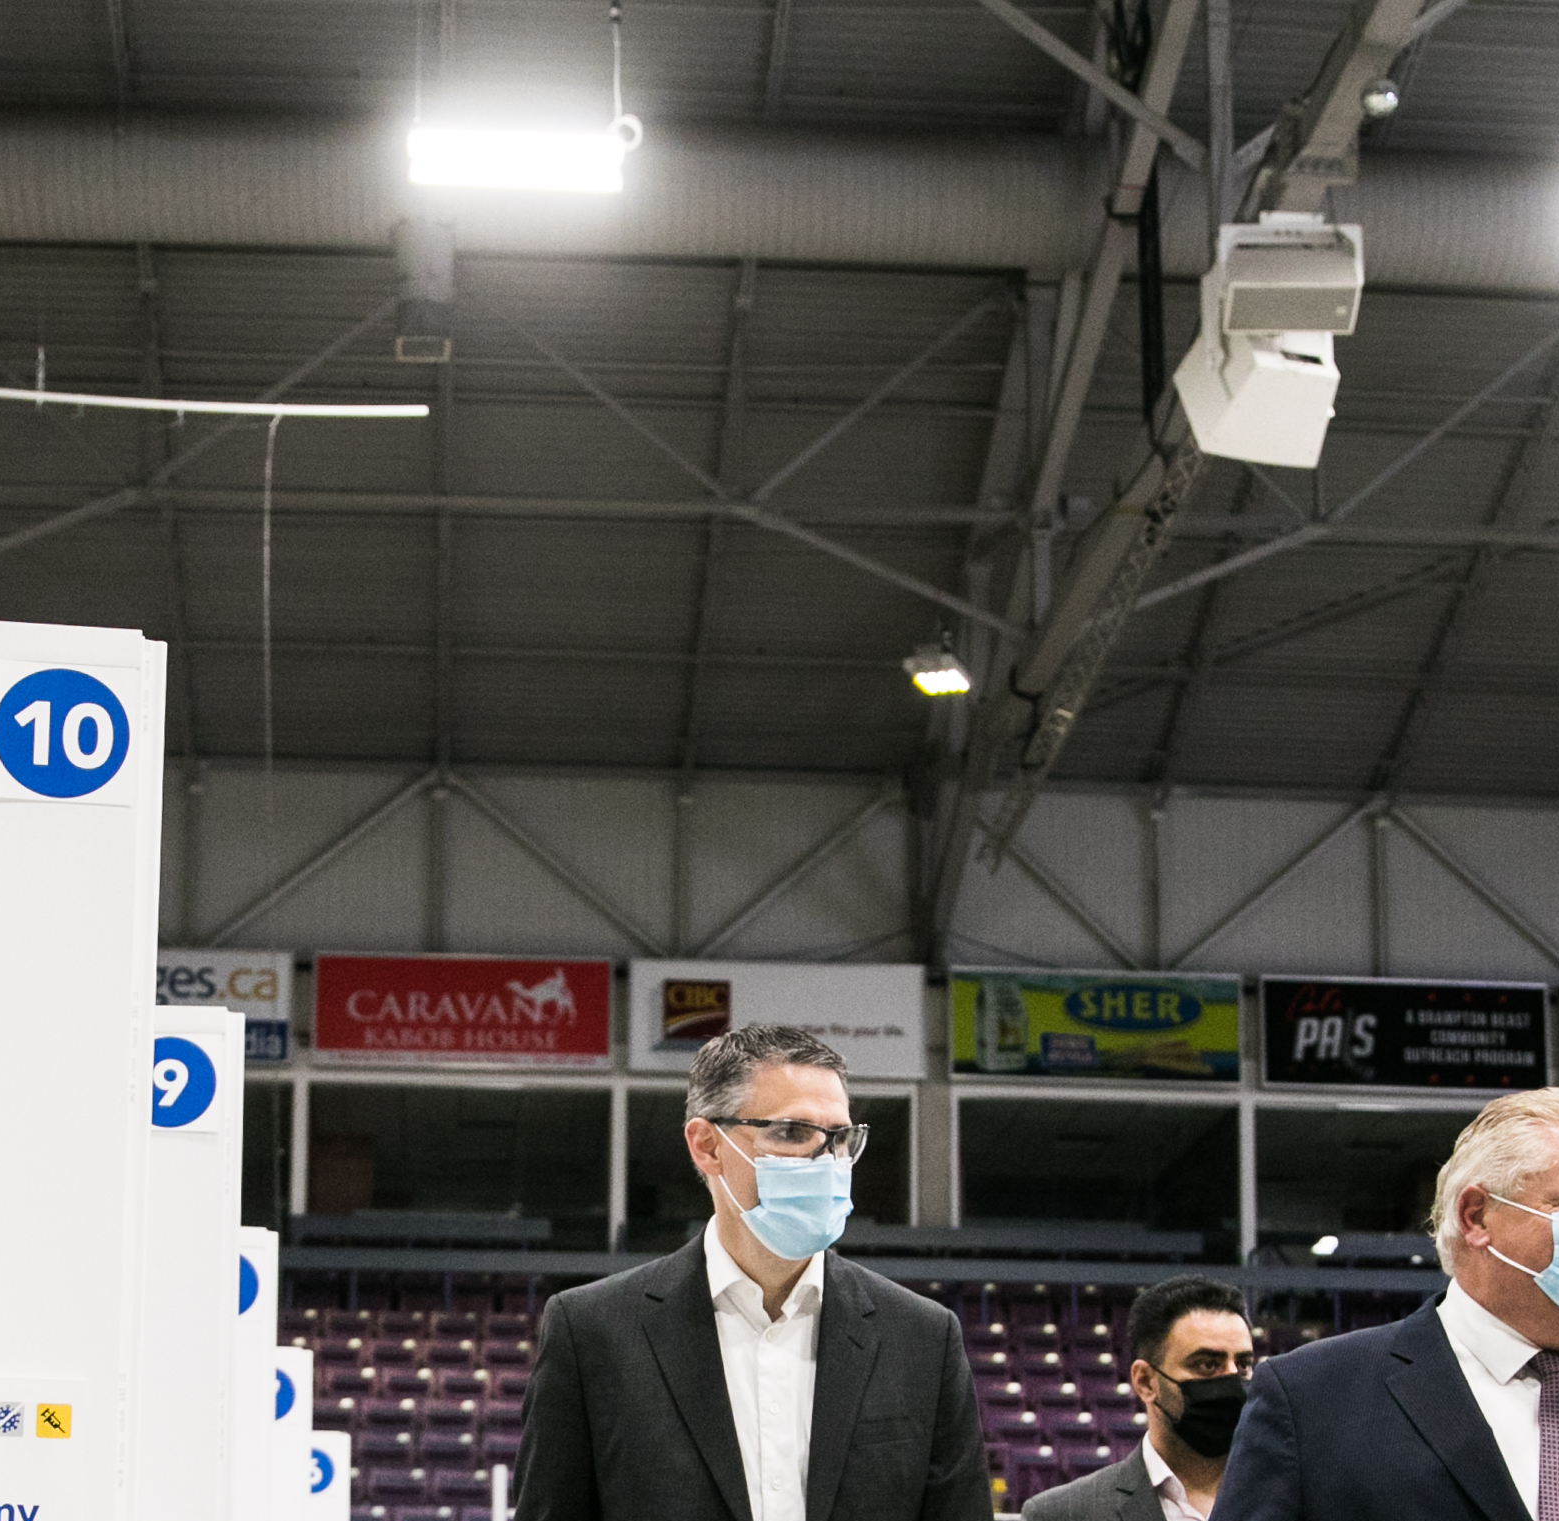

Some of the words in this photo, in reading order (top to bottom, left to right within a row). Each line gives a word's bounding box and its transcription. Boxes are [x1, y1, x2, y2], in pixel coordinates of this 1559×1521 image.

[13, 699, 115, 770] 10
[346, 988, 543, 1025] CARAVAN
[1080, 991, 1182, 1022] SHER
[153, 1058, 189, 1107] 9
